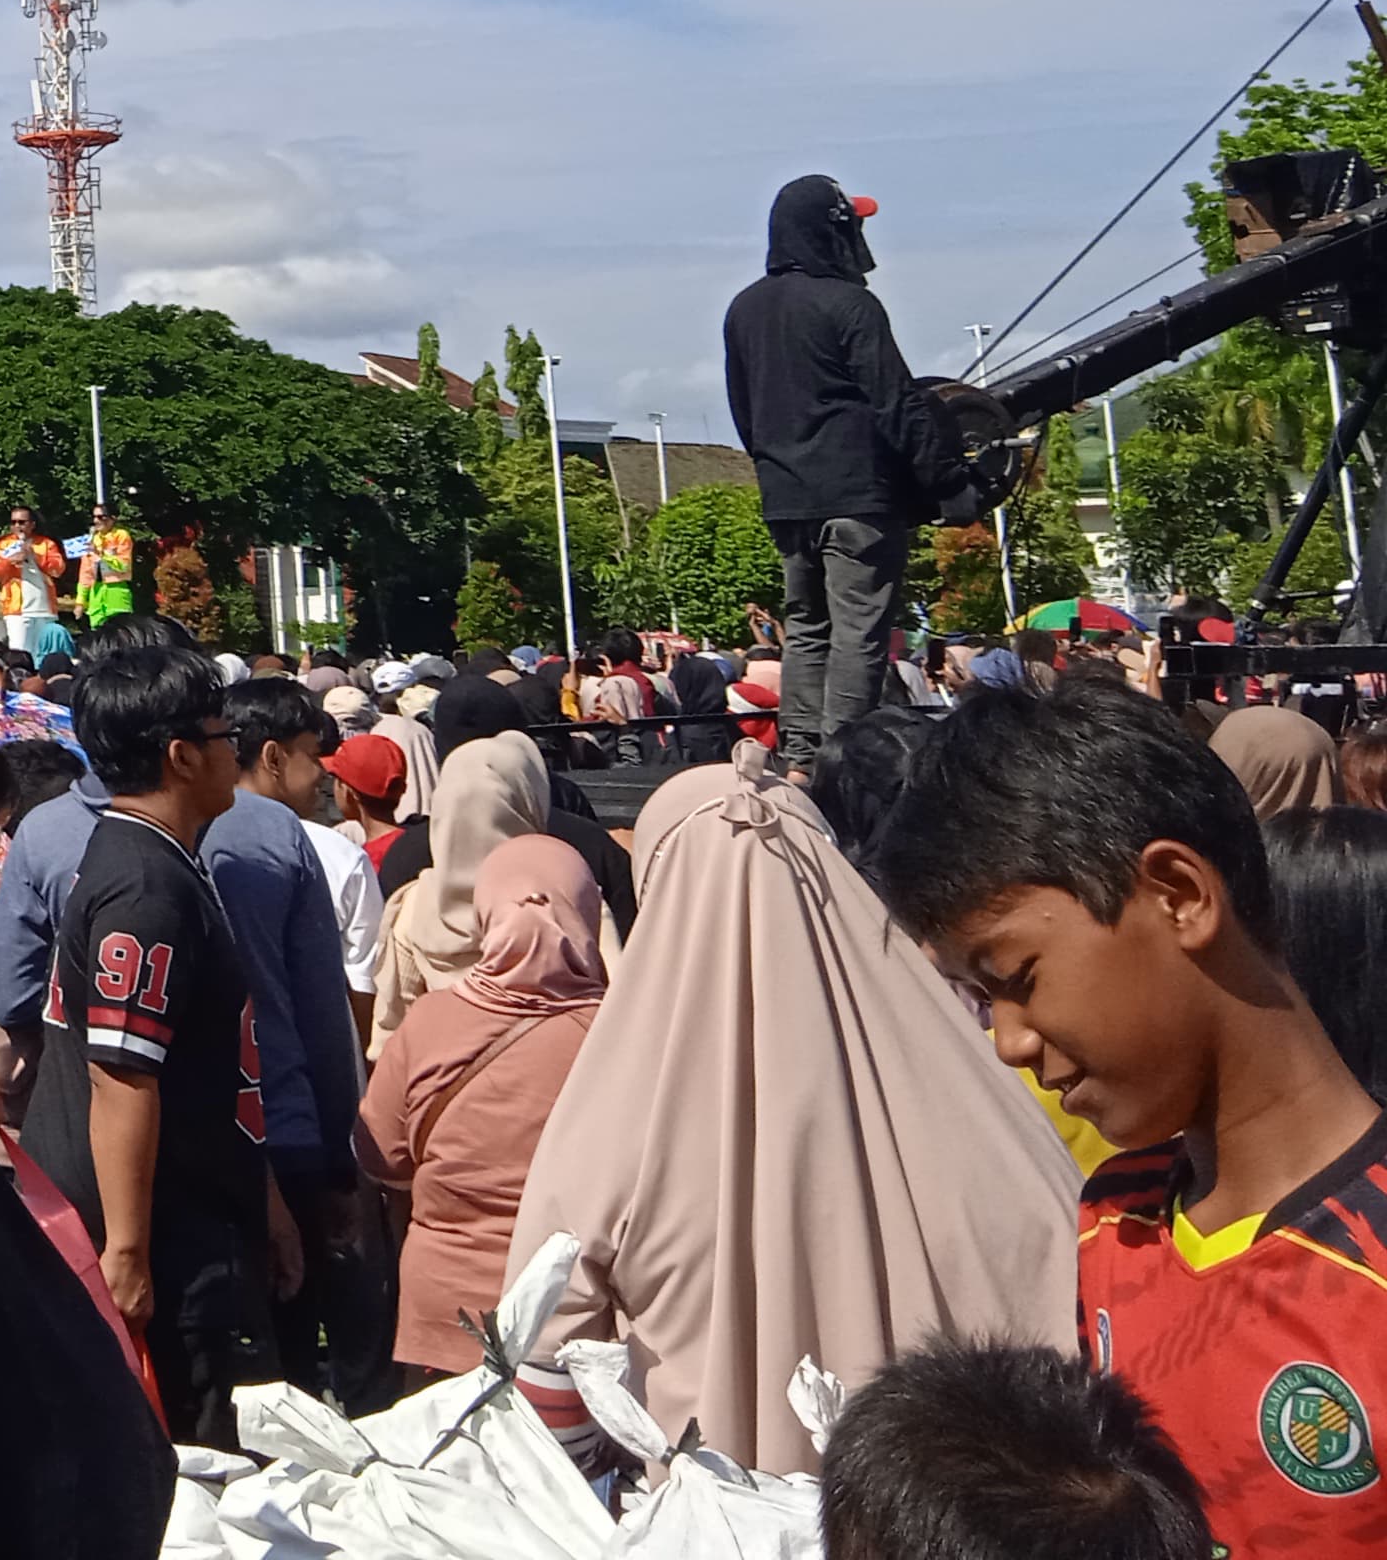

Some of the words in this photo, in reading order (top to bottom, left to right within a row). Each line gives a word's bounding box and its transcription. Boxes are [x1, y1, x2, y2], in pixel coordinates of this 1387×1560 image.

[95, 931, 173, 1015] 91
[1298, 1399, 1316, 1420] U
[1323, 1436, 1339, 1454] J
